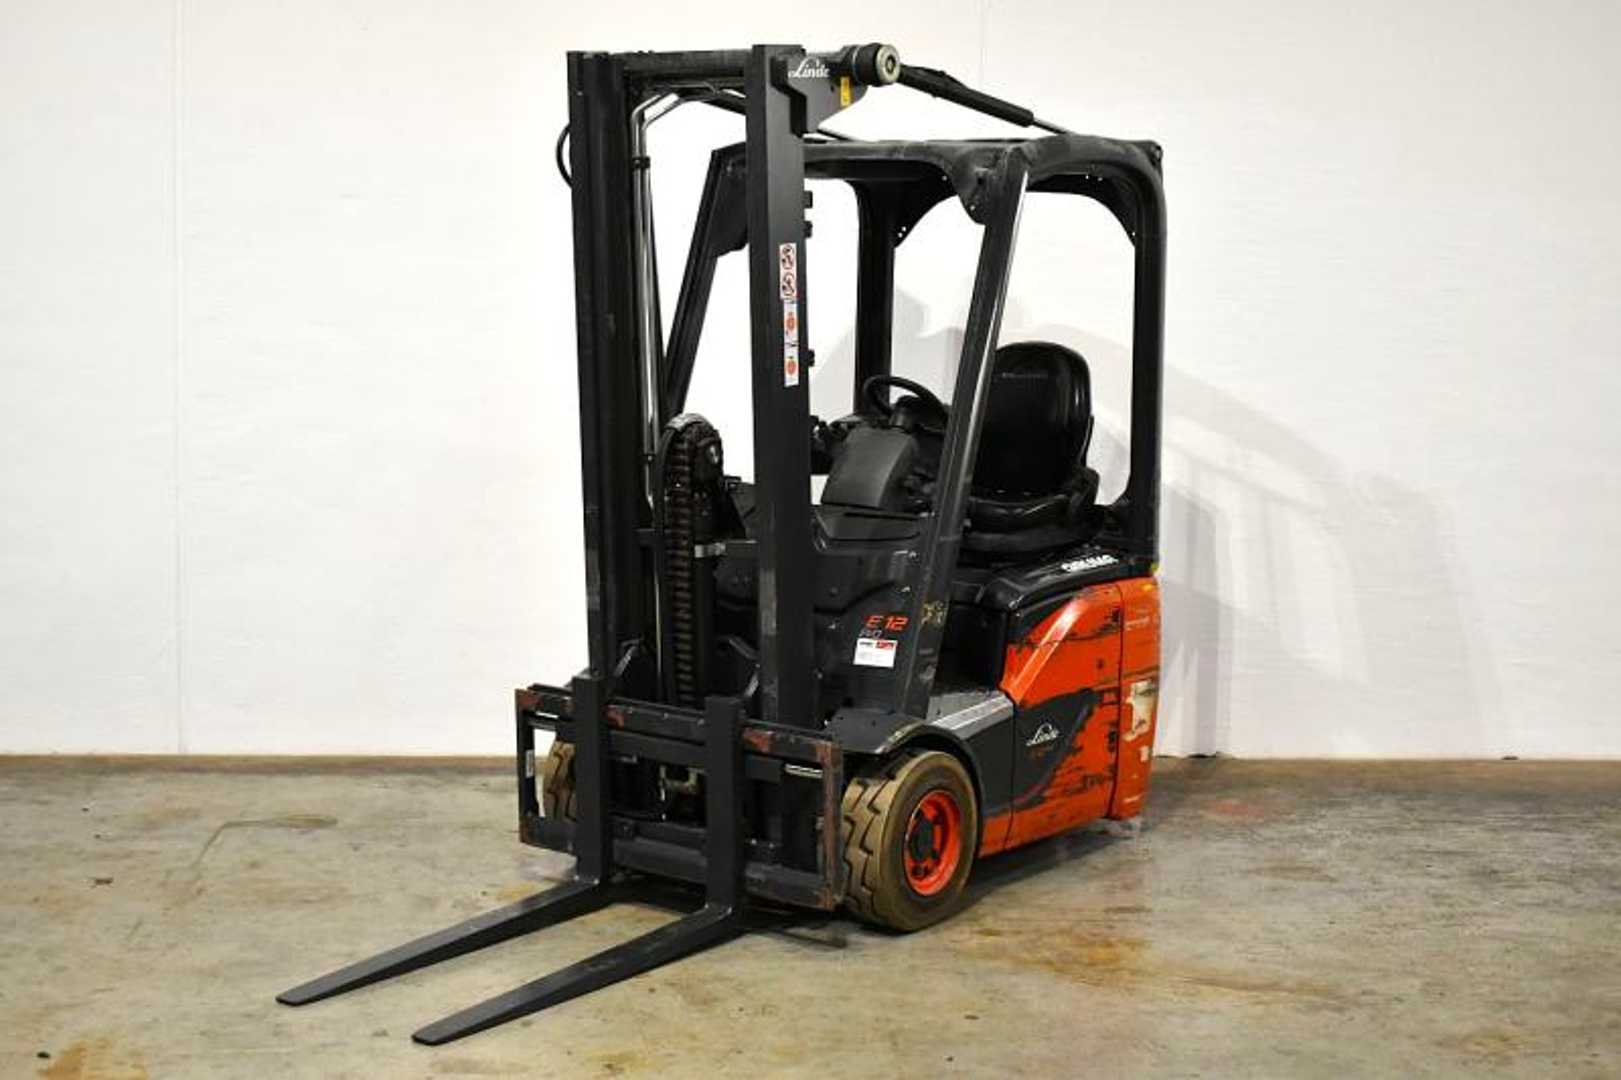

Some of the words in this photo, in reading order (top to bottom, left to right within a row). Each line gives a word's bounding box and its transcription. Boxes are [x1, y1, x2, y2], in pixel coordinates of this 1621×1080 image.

[788, 56, 831, 79] Linde
[864, 615, 883, 629] E
[885, 614, 909, 631] 12
